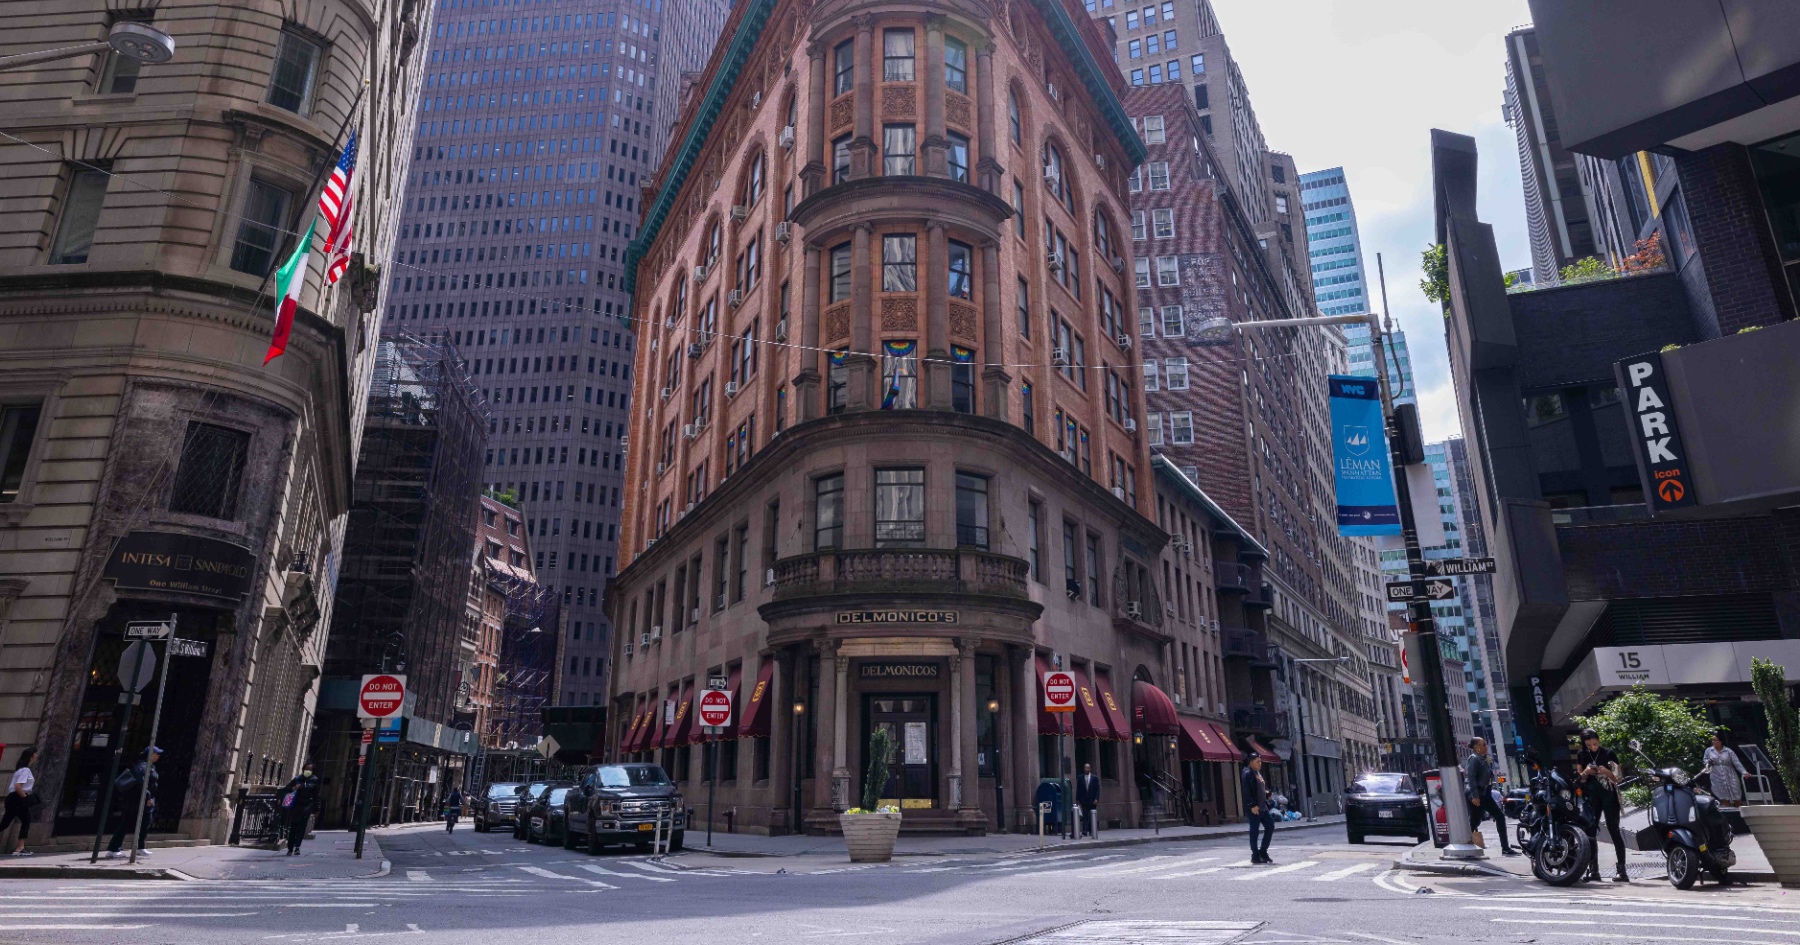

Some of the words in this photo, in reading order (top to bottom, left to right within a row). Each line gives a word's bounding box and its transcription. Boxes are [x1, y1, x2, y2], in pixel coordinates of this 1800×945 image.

[1341, 384, 1365, 395] NYC
[1628, 361, 1678, 464] PARK
[1654, 468, 1680, 479] icon
[121, 552, 171, 567] INTESA
[1446, 563, 1487, 574] WILLIAM
[150, 579, 167, 587] One
[170, 581, 199, 591] William
[201, 584, 222, 594] Street
[1392, 587, 1412, 596] ONE
[840, 611, 954, 623] DELMONICO'S
[130, 627, 144, 635] ONE
[147, 627, 161, 635] WAY
[1619, 652, 1641, 669] 15
[862, 665, 937, 677] DELMONICOS
[1531, 677, 1546, 714] PARK
